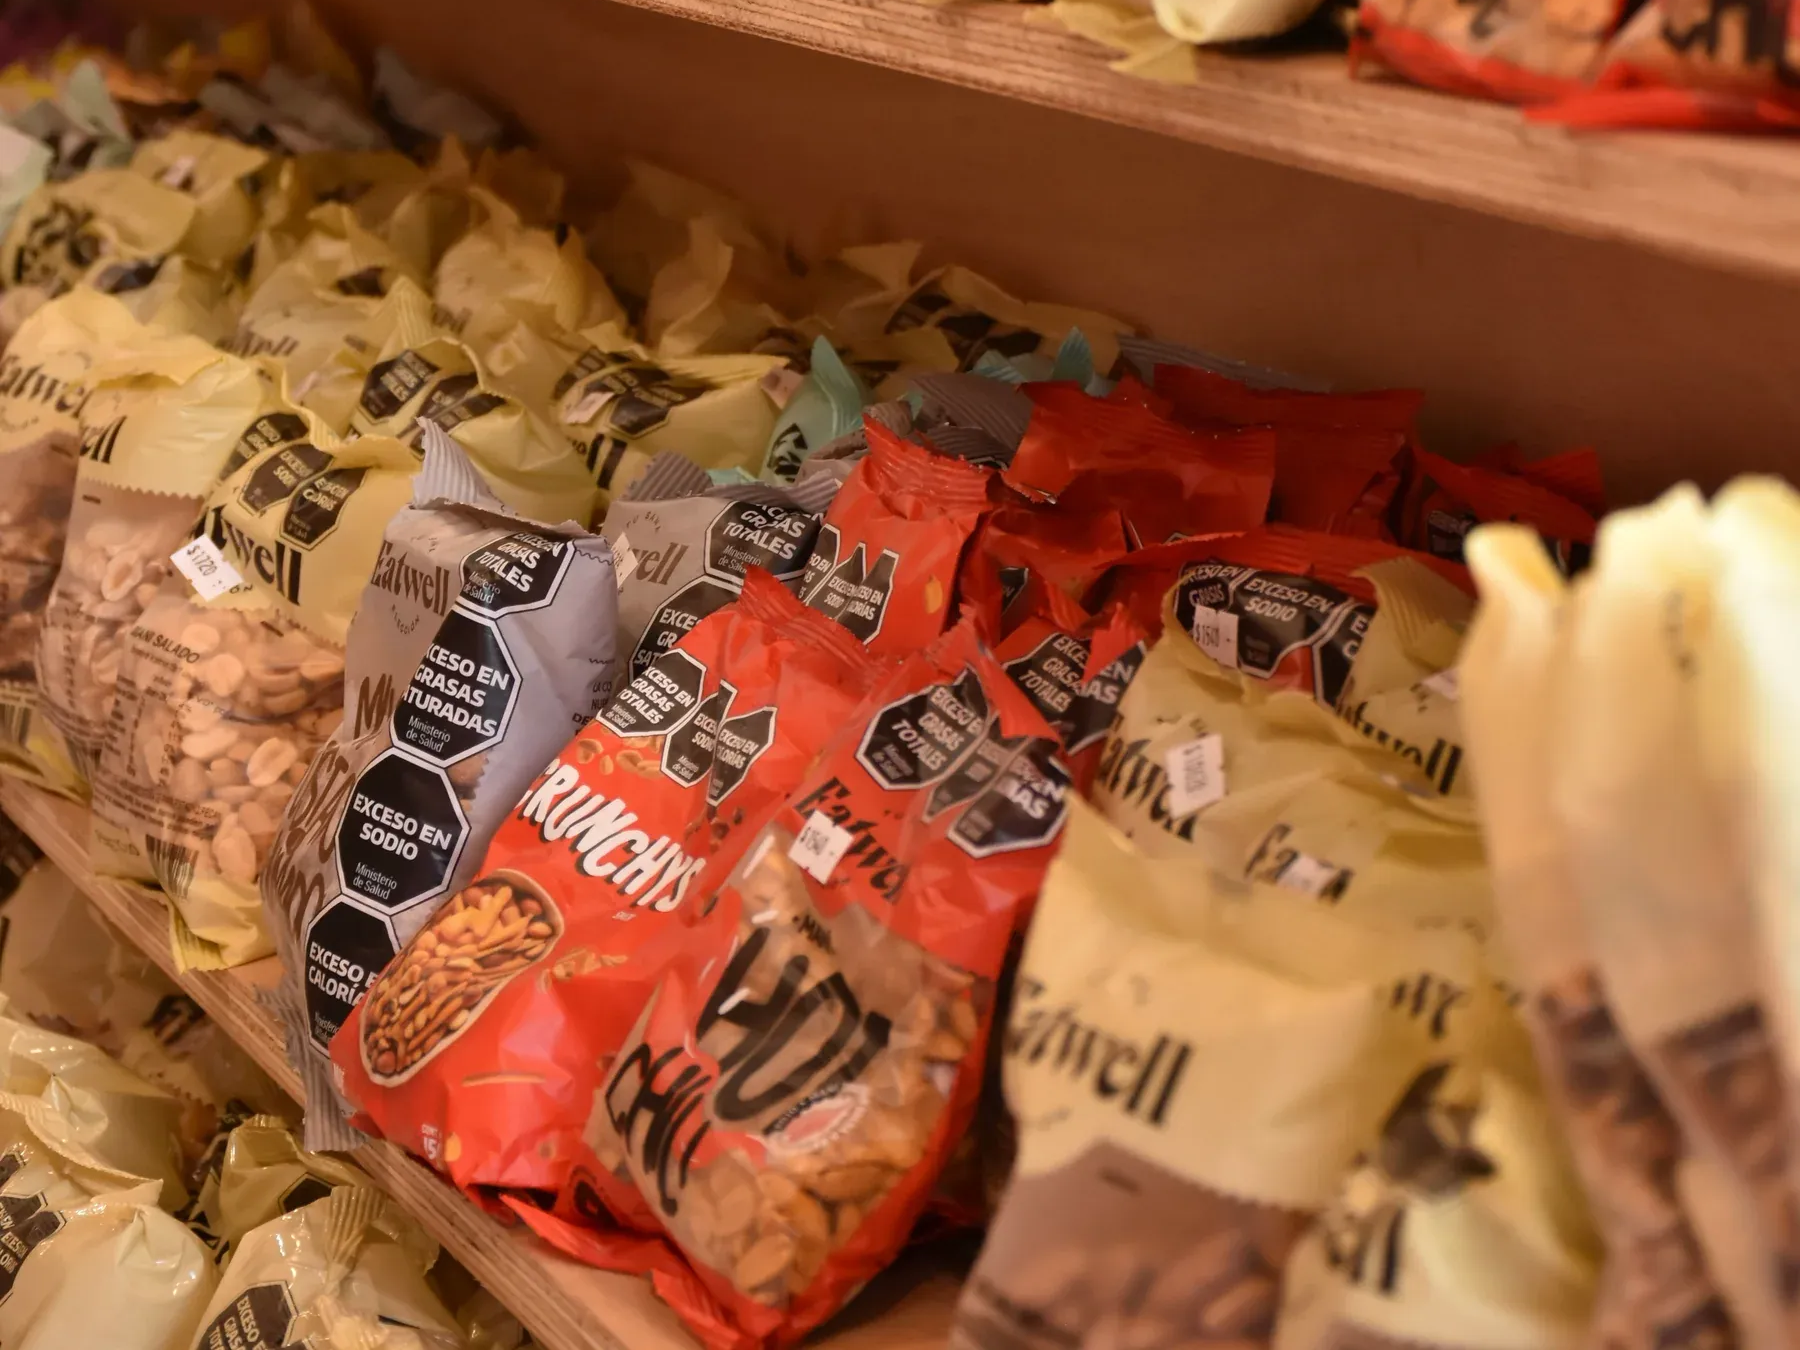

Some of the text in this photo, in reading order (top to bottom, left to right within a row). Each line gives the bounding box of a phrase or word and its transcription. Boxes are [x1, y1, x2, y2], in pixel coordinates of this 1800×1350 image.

[195, 503, 303, 605] twell
[497, 541, 541, 570] GRASAS
[722, 521, 798, 562] TOTALES
[370, 539, 451, 618] Eatwell
[475, 550, 534, 593] TOTALES
[718, 555, 729, 568] de
[468, 570, 501, 595] Ministerio
[470, 585, 495, 604] Salud
[1244, 577, 1335, 615] EXCESO EN
[1243, 597, 1299, 623] SODIO
[151, 632, 201, 665] SALADO
[413, 664, 487, 709] GRASAS
[474, 664, 511, 692] EN
[630, 677, 676, 713] GRASAS
[1018, 669, 1073, 713] TOTALES
[401, 685, 498, 738] ATURADAS
[673, 688, 695, 708] EN
[405, 727, 446, 754] de Salud
[407, 714, 451, 744] Ministerio
[693, 712, 718, 736] EXCES
[918, 711, 965, 752] GRASAS
[716, 745, 747, 770] LORÍAS
[743, 739, 760, 756] EN
[891, 718, 949, 771] TOTALES
[351, 791, 453, 852] EXCESO EN
[520, 758, 708, 912] RUNCHYS
[794, 776, 904, 902] Eatwe
[358, 820, 420, 862] SODIO
[352, 875, 392, 901] de Salud
[354, 861, 398, 891] Ministerio
[308, 940, 365, 984] EXCESO
[236, 1295, 261, 1344] EXCESO
